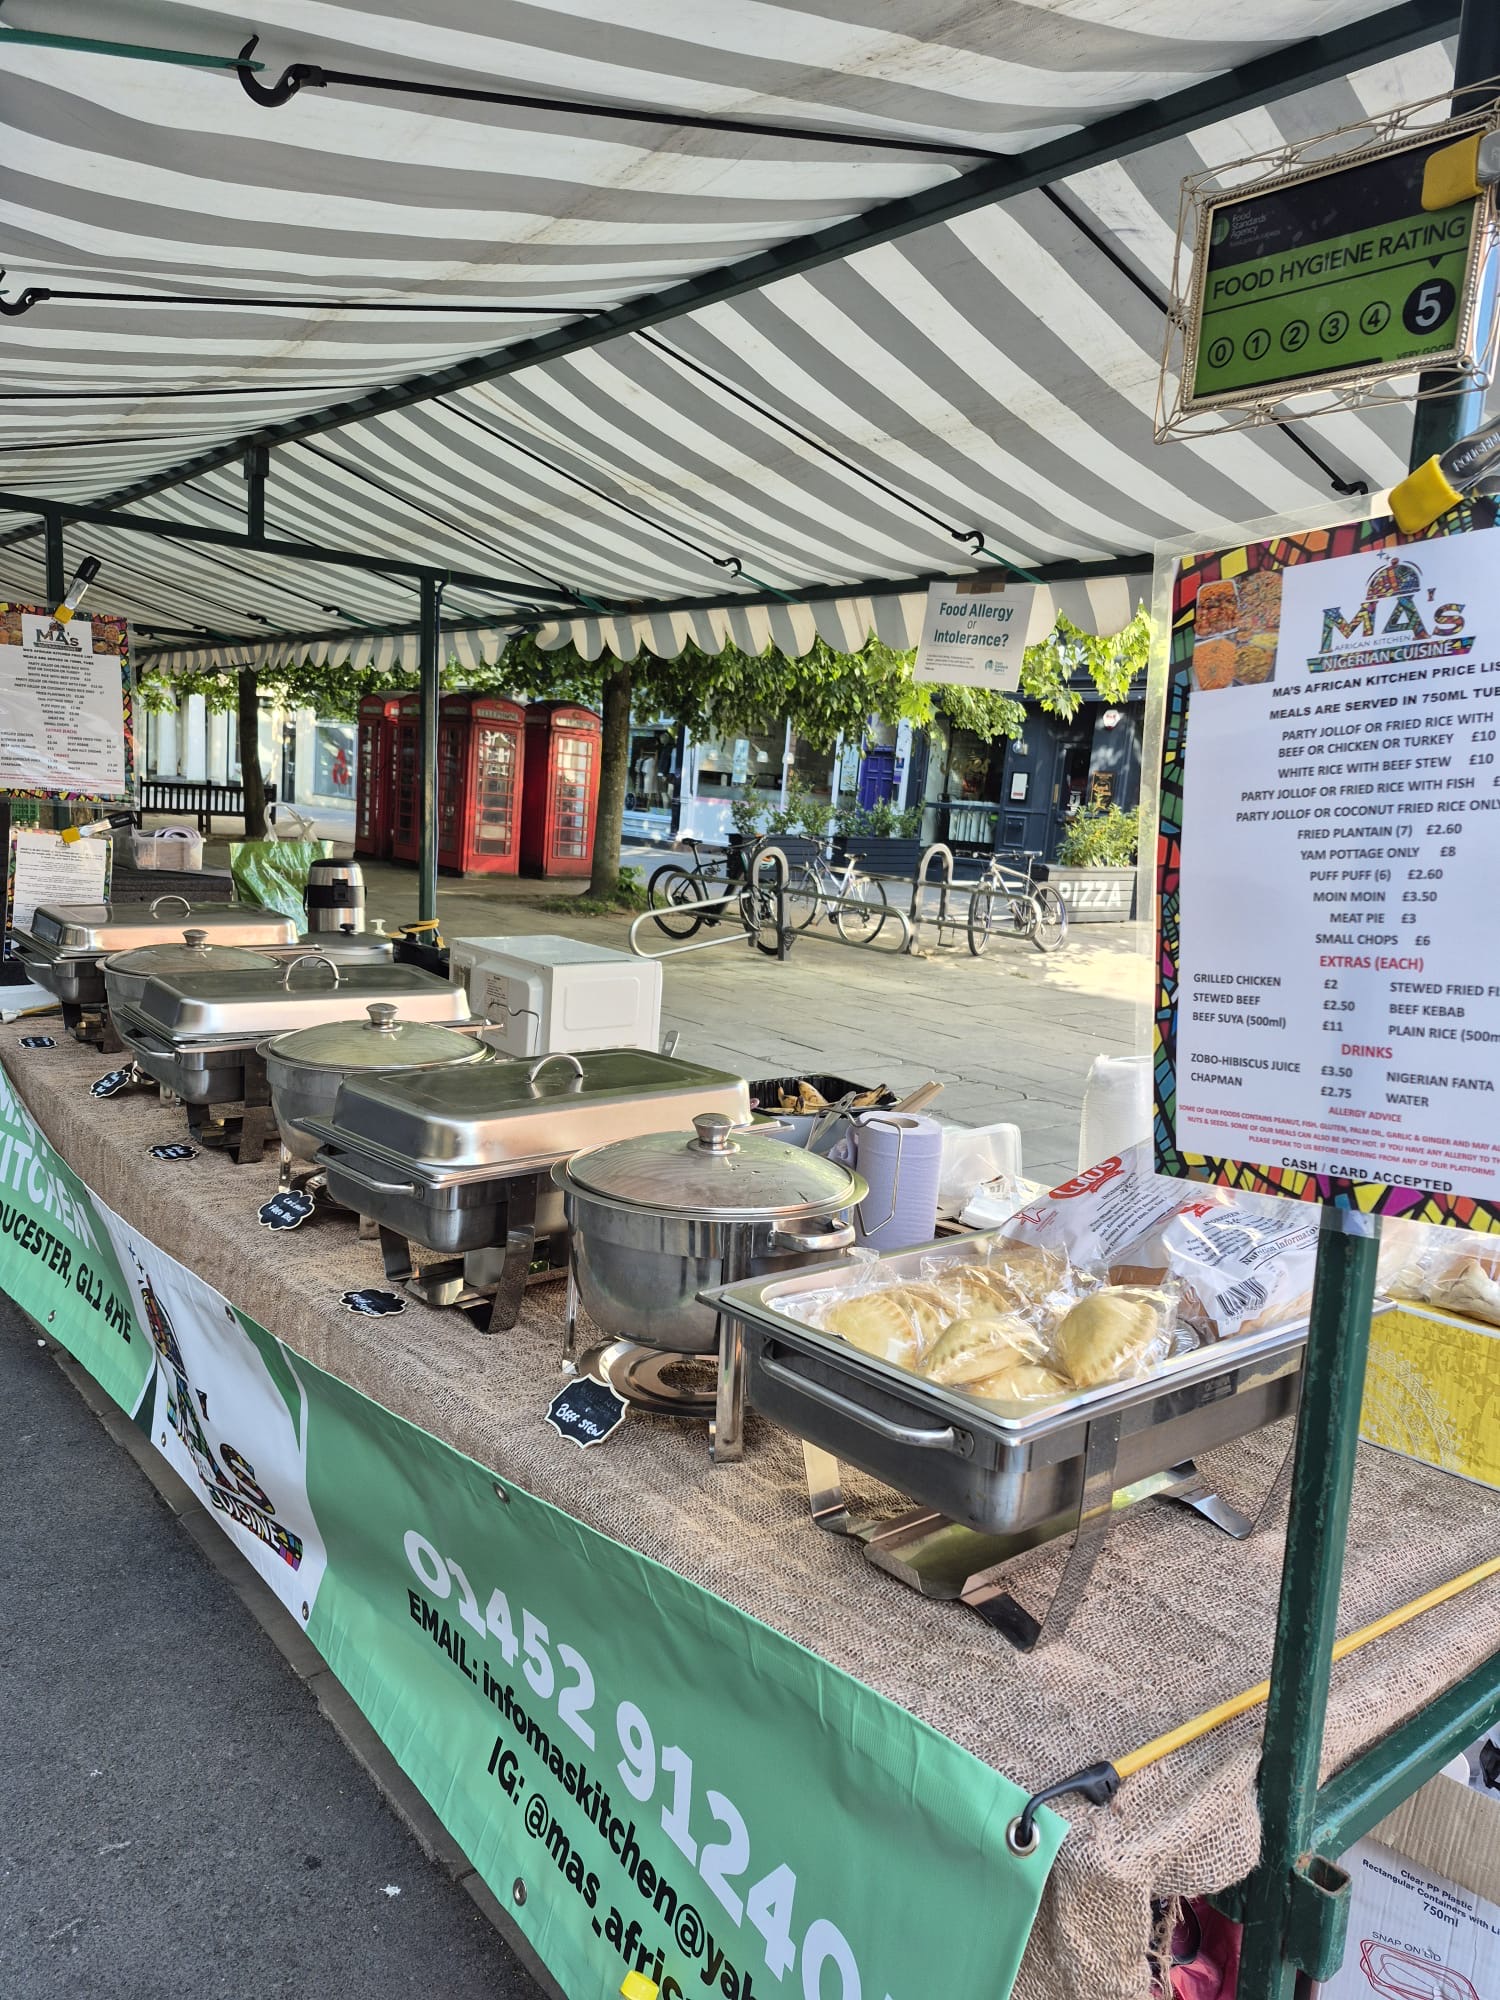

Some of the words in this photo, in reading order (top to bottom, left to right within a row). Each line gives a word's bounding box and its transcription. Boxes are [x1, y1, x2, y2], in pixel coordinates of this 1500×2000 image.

[1213, 269, 1274, 300] FOOD
[1280, 241, 1373, 283] HYGIENE
[1379, 217, 1466, 257] RATING
[1415, 286, 1441, 327] 5
[939, 602, 966, 616] Food
[969, 604, 1014, 622] Allergy
[967, 620, 976, 629] or
[1319, 587, 1466, 655] MA'S
[934, 629, 1008, 647] Intolerance?
[1334, 639, 1371, 651] AFRICAN
[1374, 635, 1411, 646] KITCHEN
[1322, 651, 1390, 670] NIGERIAN
[1393, 642, 1453, 661] CUISINE
[1272, 686, 1301, 697] MA'S
[1304, 678, 1362, 693] AFRICAN
[1366, 670, 1427, 686] KITCHEN
[1432, 664, 1476, 678] PRICE
[1269, 707, 1311, 720] MEALS
[1315, 704, 1341, 714] ARE
[1345, 698, 1397, 711] SERVED
[1403, 695, 1417, 705] IN
[1422, 690, 1468, 703] 750ML
[1282, 728, 1317, 741] PARTY
[1320, 724, 1362, 738] JOLLOF
[1365, 723, 1382, 732] OR
[1386, 719, 1421, 731] FRIED
[1425, 716, 1453, 727] RICE
[1458, 712, 1494, 724] WITH
[1279, 746, 1305, 757] BEEF
[1307, 745, 1324, 755] OR
[1328, 740, 1379, 753] CHICKEN
[1382, 739, 1400, 749] OR
[1404, 733, 1454, 747] TURKEY
[1472, 730, 1496, 742] £10
[1278, 767, 1314, 778] WHITE
[1318, 764, 1343, 775] RICE
[1346, 762, 1379, 774] WITH
[1383, 760, 1411, 771] BEEF
[1415, 756, 1452, 769] STEW
[1469, 753, 1494, 765] £10
[1241, 790, 1275, 802] PARTY
[1277, 787, 1316, 799] JOLLOF
[1319, 787, 1336, 796] OR
[1340, 784, 1374, 795] FRIED
[1377, 782, 1404, 793] RICE
[1408, 779, 1442, 791] WITH
[1446, 777, 1475, 789] FISH
[1236, 811, 1269, 822] PARTY
[1272, 809, 1311, 820] JOLLOF
[1314, 808, 1331, 818] OR
[1334, 804, 1393, 816] COCONUT
[1397, 803, 1433, 814] FRIED
[1437, 801, 1466, 812] RICE
[1469, 799, 1500, 811] ONLY
[1297, 829, 1330, 839] FRIED
[1333, 826, 1392, 838] PLANTAIN
[1396, 825, 1413, 838] (7)
[1426, 824, 1462, 835] £2.60
[1300, 850, 1326, 860] YAM
[1330, 848, 1384, 859] POTTAGE
[1387, 847, 1420, 858] ONLY
[1440, 846, 1456, 857] £8
[1310, 871, 1339, 881] PUFF
[1342, 870, 1372, 880] PUFF
[1375, 869, 1392, 882] (6)
[1408, 869, 1443, 880] £2.60
[1058, 881, 1121, 907] PIZZA
[1313, 892, 1347, 902] MOIN
[1350, 892, 1386, 902] MOIN
[1402, 891, 1438, 902] £3.50
[1329, 913, 1363, 923] MEAT
[1366, 913, 1385, 923] PIE
[1401, 913, 1417, 924] £3
[1315, 934, 1354, 944] SMALL
[1357, 935, 1398, 945] CHOPS
[1415, 935, 1431, 946] £6
[1320, 956, 1371, 968] EXTRAS
[1375, 956, 1424, 972] (EACH)
[1193, 973, 1234, 984] GRILLED
[1236, 976, 1281, 986] CHICKEN
[1324, 979, 1338, 989] £2
[1390, 982, 1442, 994] STEWED
[1446, 984, 1484, 996] FRIED
[1193, 993, 1234, 1004] STEWED
[1236, 995, 1261, 1005] BEEF
[1323, 1000, 1355, 1012] £2.50
[1389, 1004, 1420, 1015] BEEF
[1422, 1005, 1465, 1018] KEBAB
[1192, 1012, 1216, 1022] BEEF
[1218, 1014, 1244, 1024] SUYA
[1246, 1015, 1286, 1029] (500ml)
[1322, 1021, 1343, 1032] £11
[1388, 1025, 1425, 1037] PLAIN
[1429, 1028, 1457, 1039] RICE
[1341, 1044, 1393, 1059] DRINKS
[1191, 1053, 1269, 1069] ZOBO-HIBISCUS
[1271, 1061, 1301, 1072] JUICE
[1321, 1066, 1353, 1078] £3.50
[1386, 1072, 1448, 1087] NIGERIAN
[1452, 1077, 1495, 1091] FANTA
[1191, 1072, 1243, 1086] CHAPMAN
[1320, 1086, 1352, 1099] £2.75
[1386, 1093, 1429, 1107] WATER
[1328, 1107, 1366, 1118] ALLERGY
[1368, 1112, 1402, 1122] ADVICE
[1282, 1157, 1317, 1171] CASH
[1330, 1165, 1368, 1179] CARD
[1373, 1172, 1452, 1192] ACCEPTED
[0, 1199, 72, 1288] UCESTER,
[76, 1262, 104, 1312] GL1
[105, 1292, 132, 1345] 4HE
[556, 1404, 580, 1422] BEEF
[578, 1419, 604, 1437] STEW
[208, 1486, 281, 1547] CUISINE
[406, 1589, 479, 1686] EMAIL:
[404, 1529, 596, 1751] 01452
[616, 1700, 900, 2000] 91240
[487, 1736, 525, 1805] IG:
[1363, 1859, 1415, 1891] Rectangular
[1417, 1888, 1466, 1917] Containers
[1469, 1915, 1489, 1930] with
[1401, 1869, 1424, 1885] Clear
[1442, 1890, 1473, 1911] Plastic
[1424, 1902, 1458, 1928] 750ml
[1372, 1931, 1402, 1946] SNAP
[1405, 1944, 1423, 1954] ON
[1424, 1951, 1442, 1962] LID
